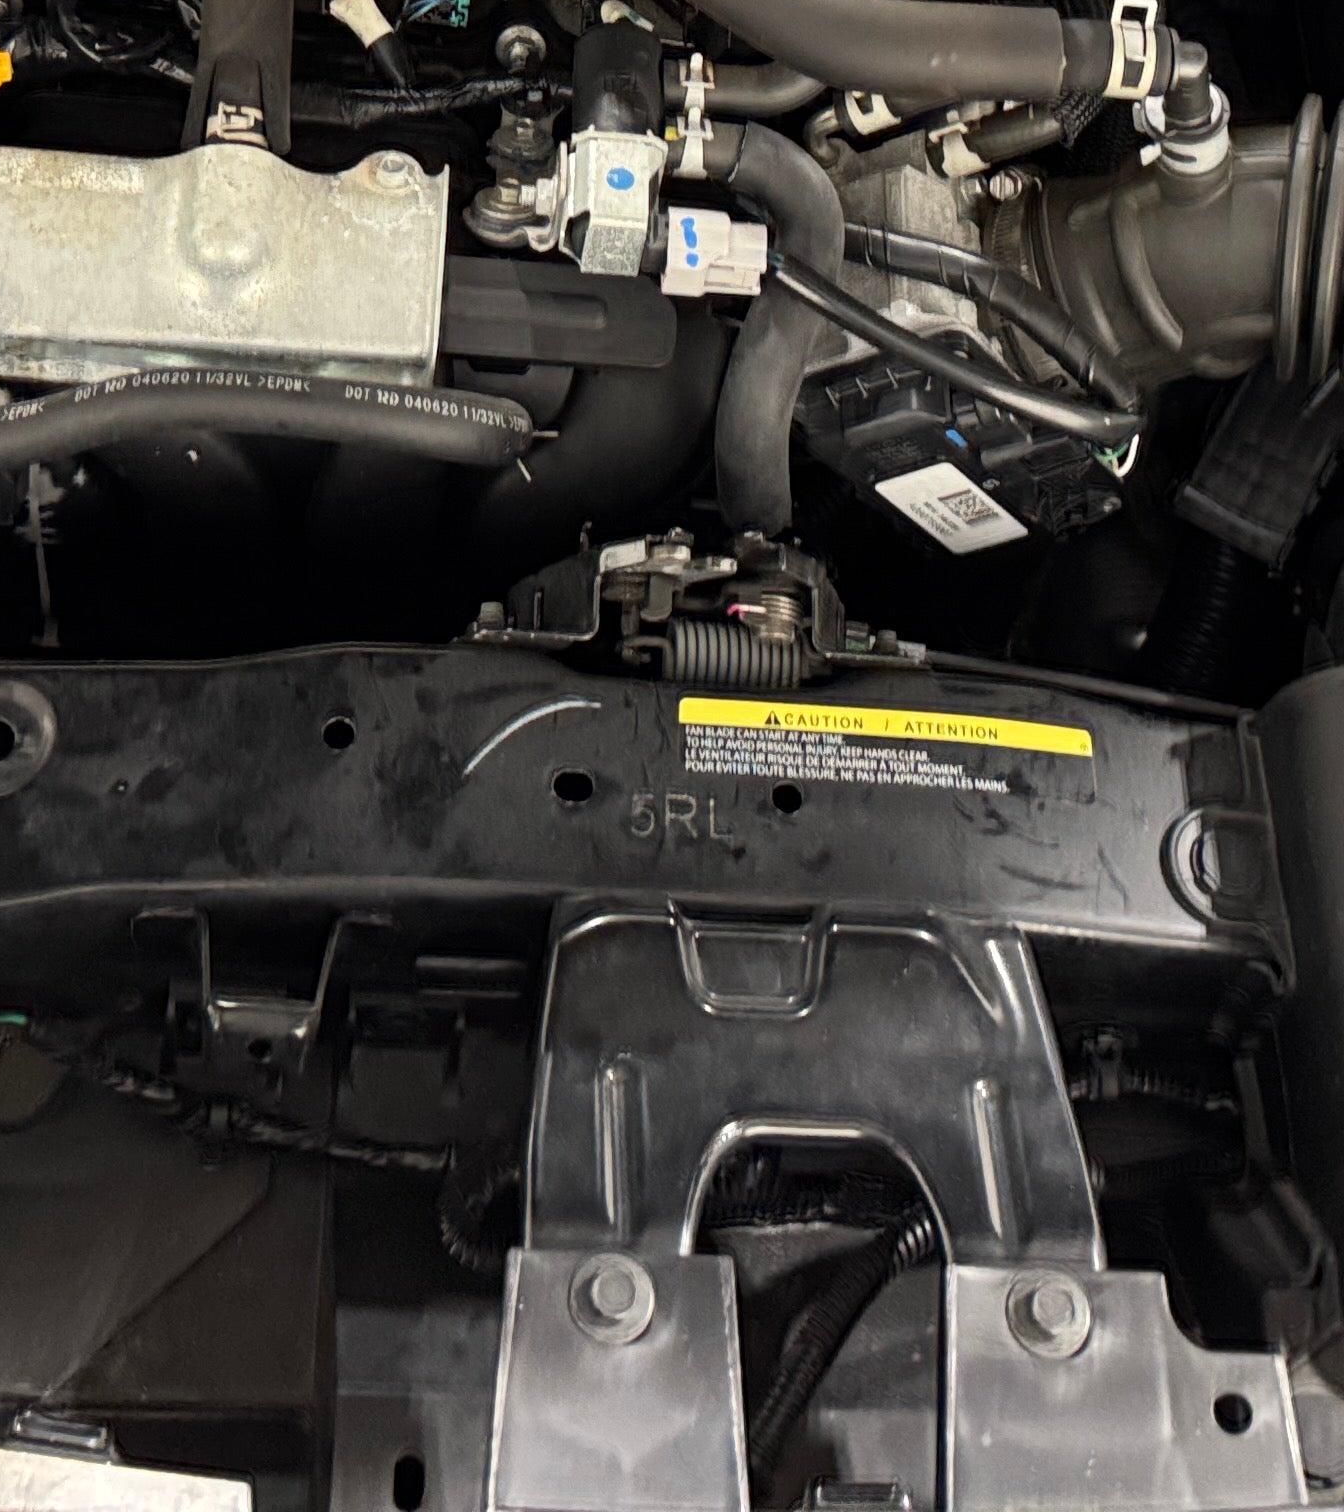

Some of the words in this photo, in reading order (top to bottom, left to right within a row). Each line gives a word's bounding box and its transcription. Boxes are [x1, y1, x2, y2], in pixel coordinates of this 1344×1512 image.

[132, 371, 190, 387] 040620
[345, 385, 369, 402] DOT
[405, 394, 458, 417] 040620
[685, 725, 703, 737] FAN
[706, 726, 734, 738] BLADE
[737, 728, 756, 739] CAN
[758, 730, 786, 740] START
[788, 731, 799, 742] AT
[801, 732, 820, 743] ANY
[784, 712, 863, 729] CAUTION
[904, 721, 998, 740] ATTENTION
[685, 748, 695, 759] LE
[698, 749, 765, 763] VENTILATEUR
[767, 754, 803, 766] RISQUE
[806, 756, 820, 767] DE
[888, 760, 915, 773] TOUT
[686, 736, 699, 747] TO
[701, 737, 723, 749] HELP
[725, 739, 754, 751] AVOID
[756, 741, 802, 753] PERSONAL
[840, 746, 863, 757] KEEP
[864, 748, 897, 760] HANDS
[685, 760, 714, 772] POUR
[752, 765, 785, 777] TOUTE
[840, 770, 854, 781] NE
[857, 771, 875, 783] PAS
[877, 772, 891, 784] EN
[894, 774, 954, 787] APPROCHER
[955, 777, 973, 789] LES
[631, 793, 734, 839] 5RL
